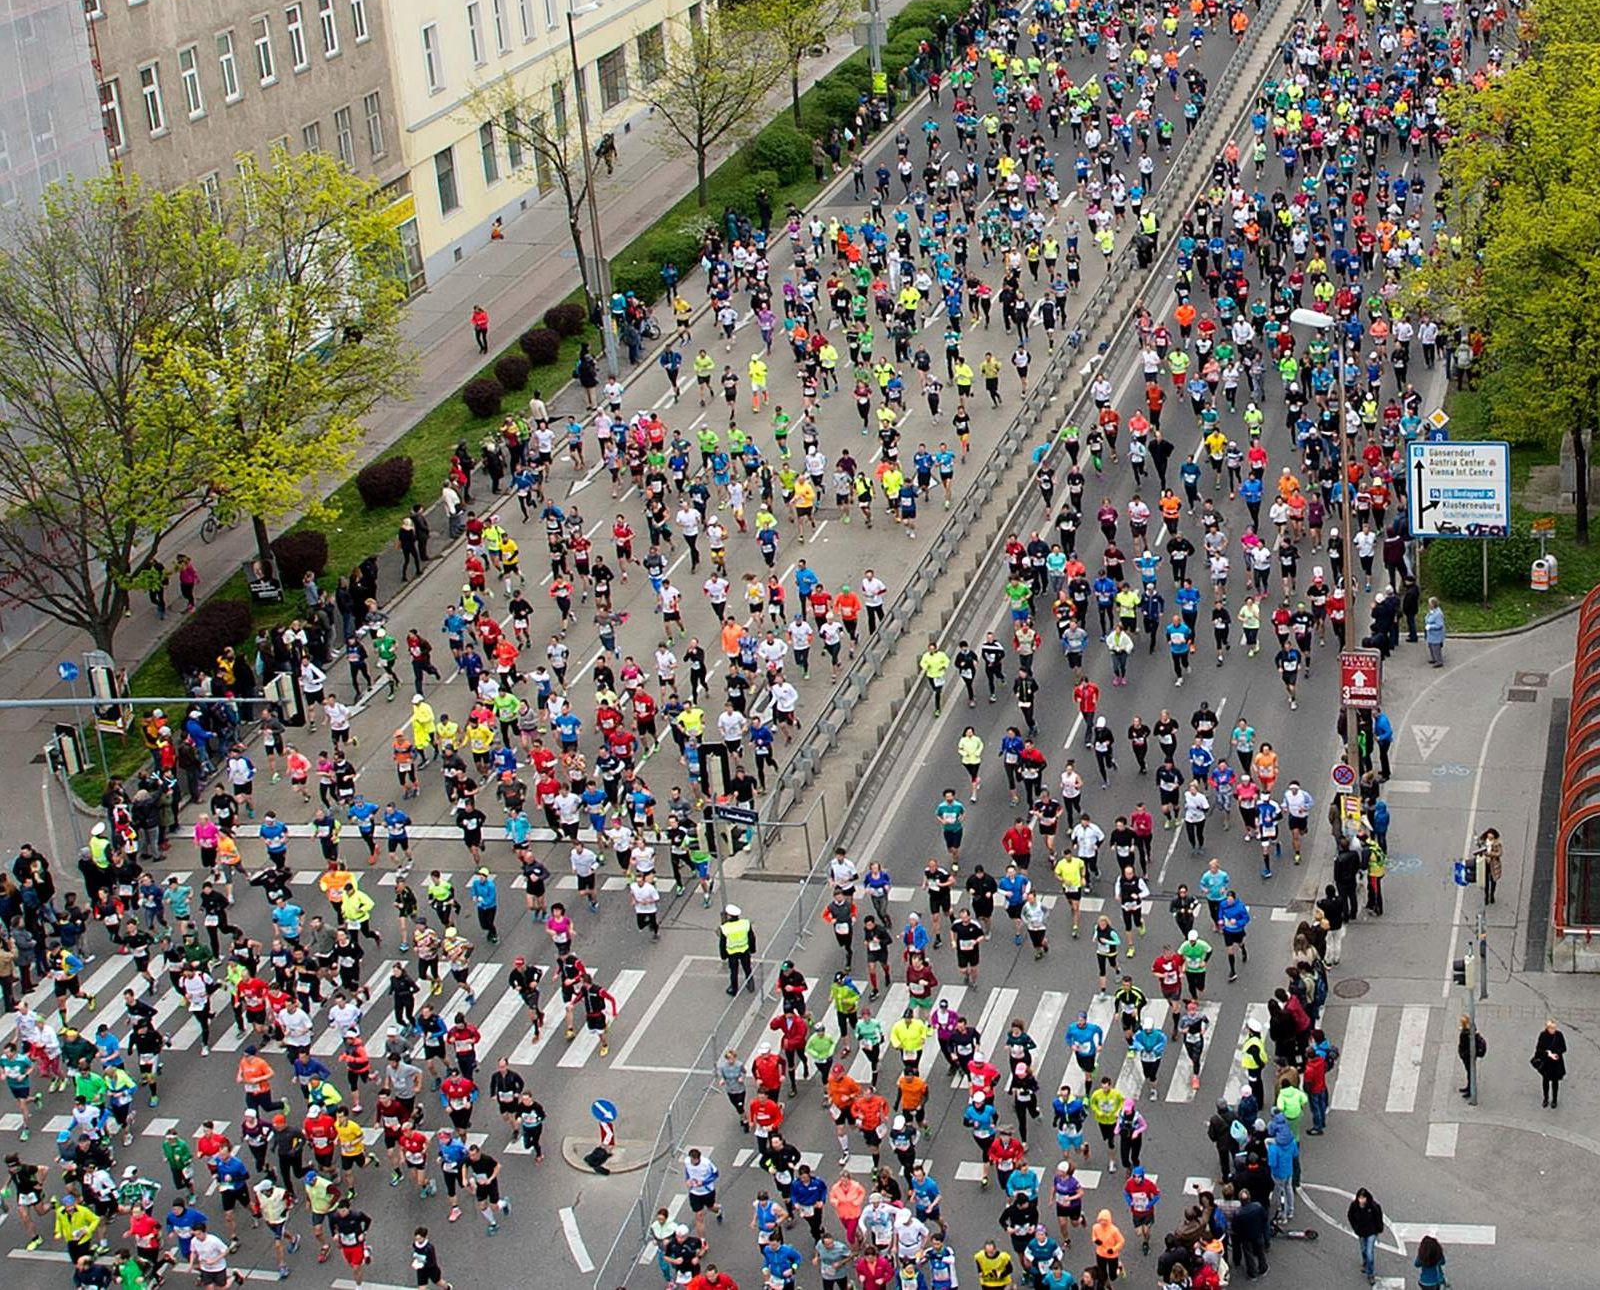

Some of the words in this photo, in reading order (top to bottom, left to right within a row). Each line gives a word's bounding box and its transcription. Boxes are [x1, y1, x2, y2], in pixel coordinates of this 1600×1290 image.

[1429, 458, 1457, 467] Austria
[1460, 458, 1485, 467] Center
[1429, 468, 1454, 477] Vienna
[1342, 686, 1350, 699] 3
